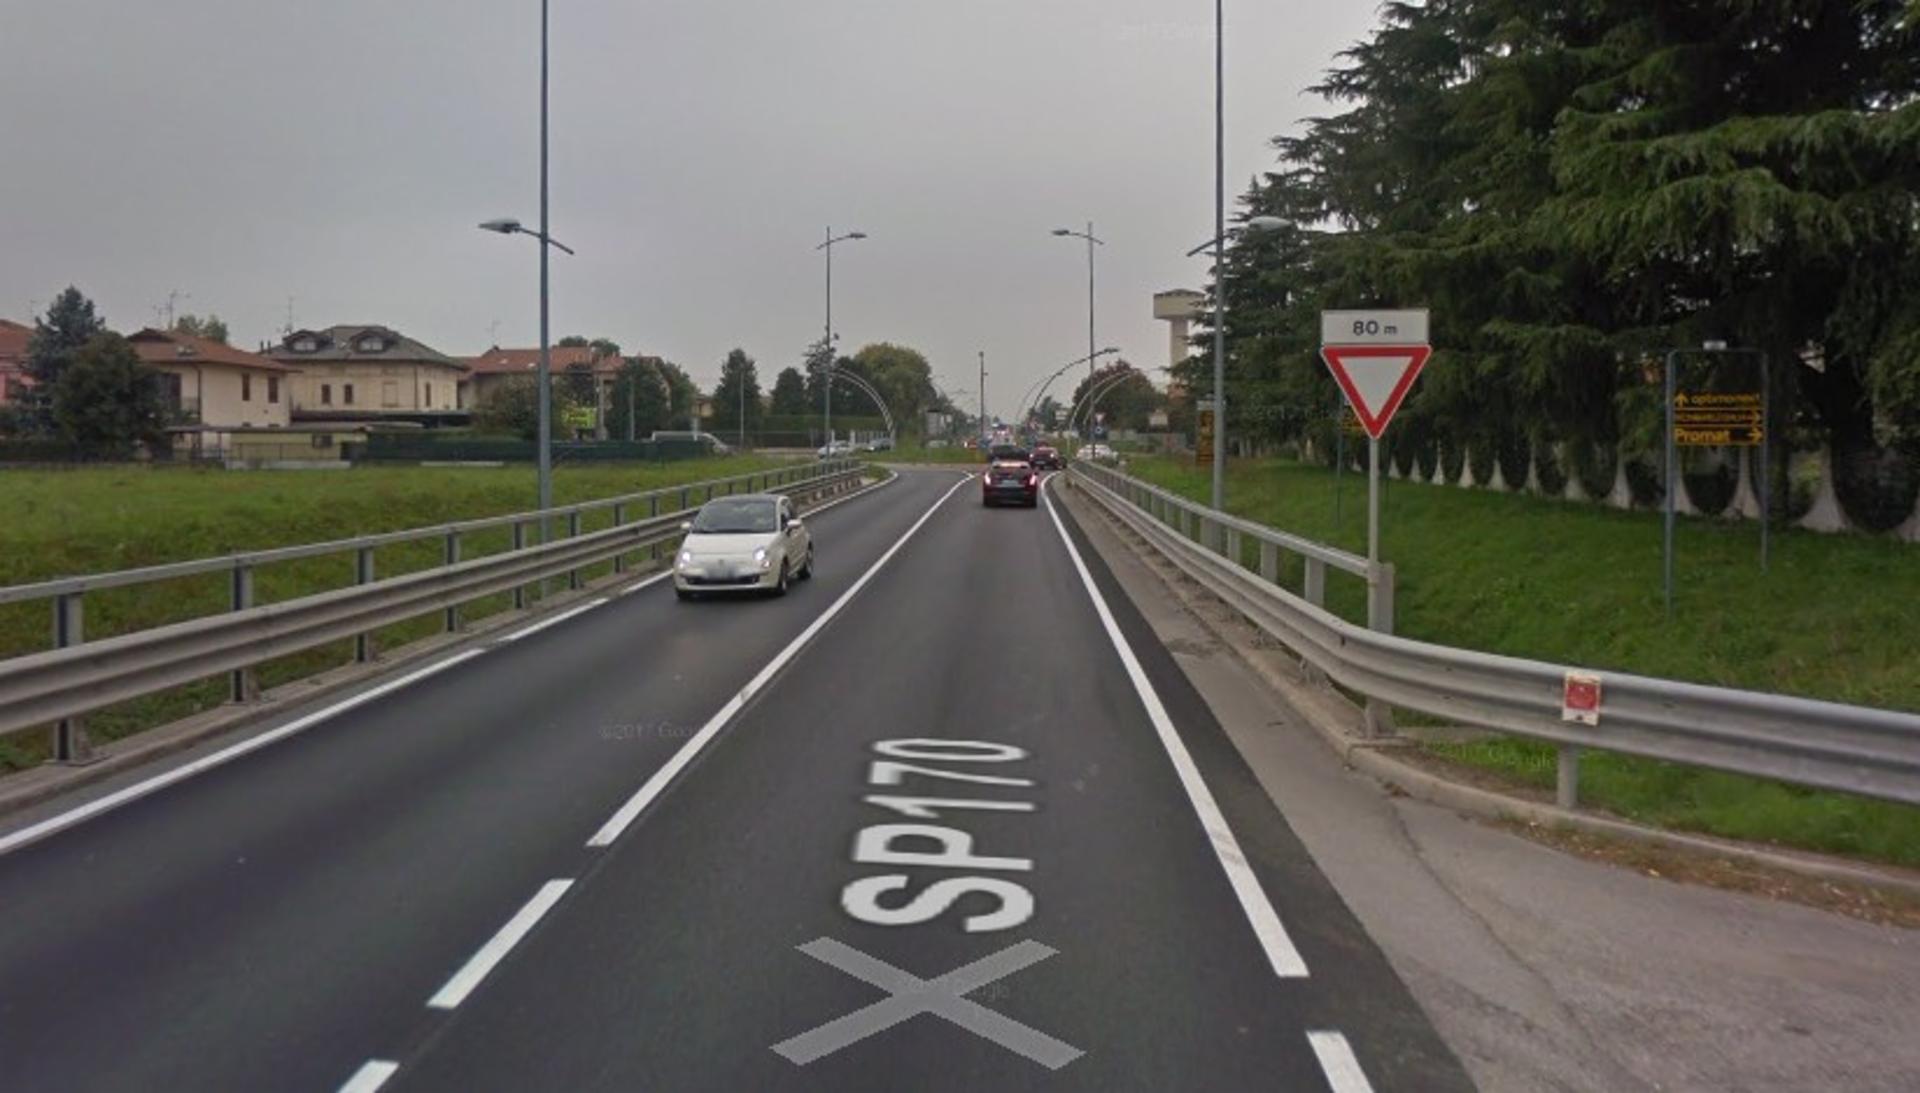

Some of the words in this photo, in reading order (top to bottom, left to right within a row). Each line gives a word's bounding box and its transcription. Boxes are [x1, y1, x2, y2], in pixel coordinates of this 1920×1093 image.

[1352, 320, 1379, 335] 80
[1384, 325, 1397, 334] m
[840, 738, 1036, 932] SP170
